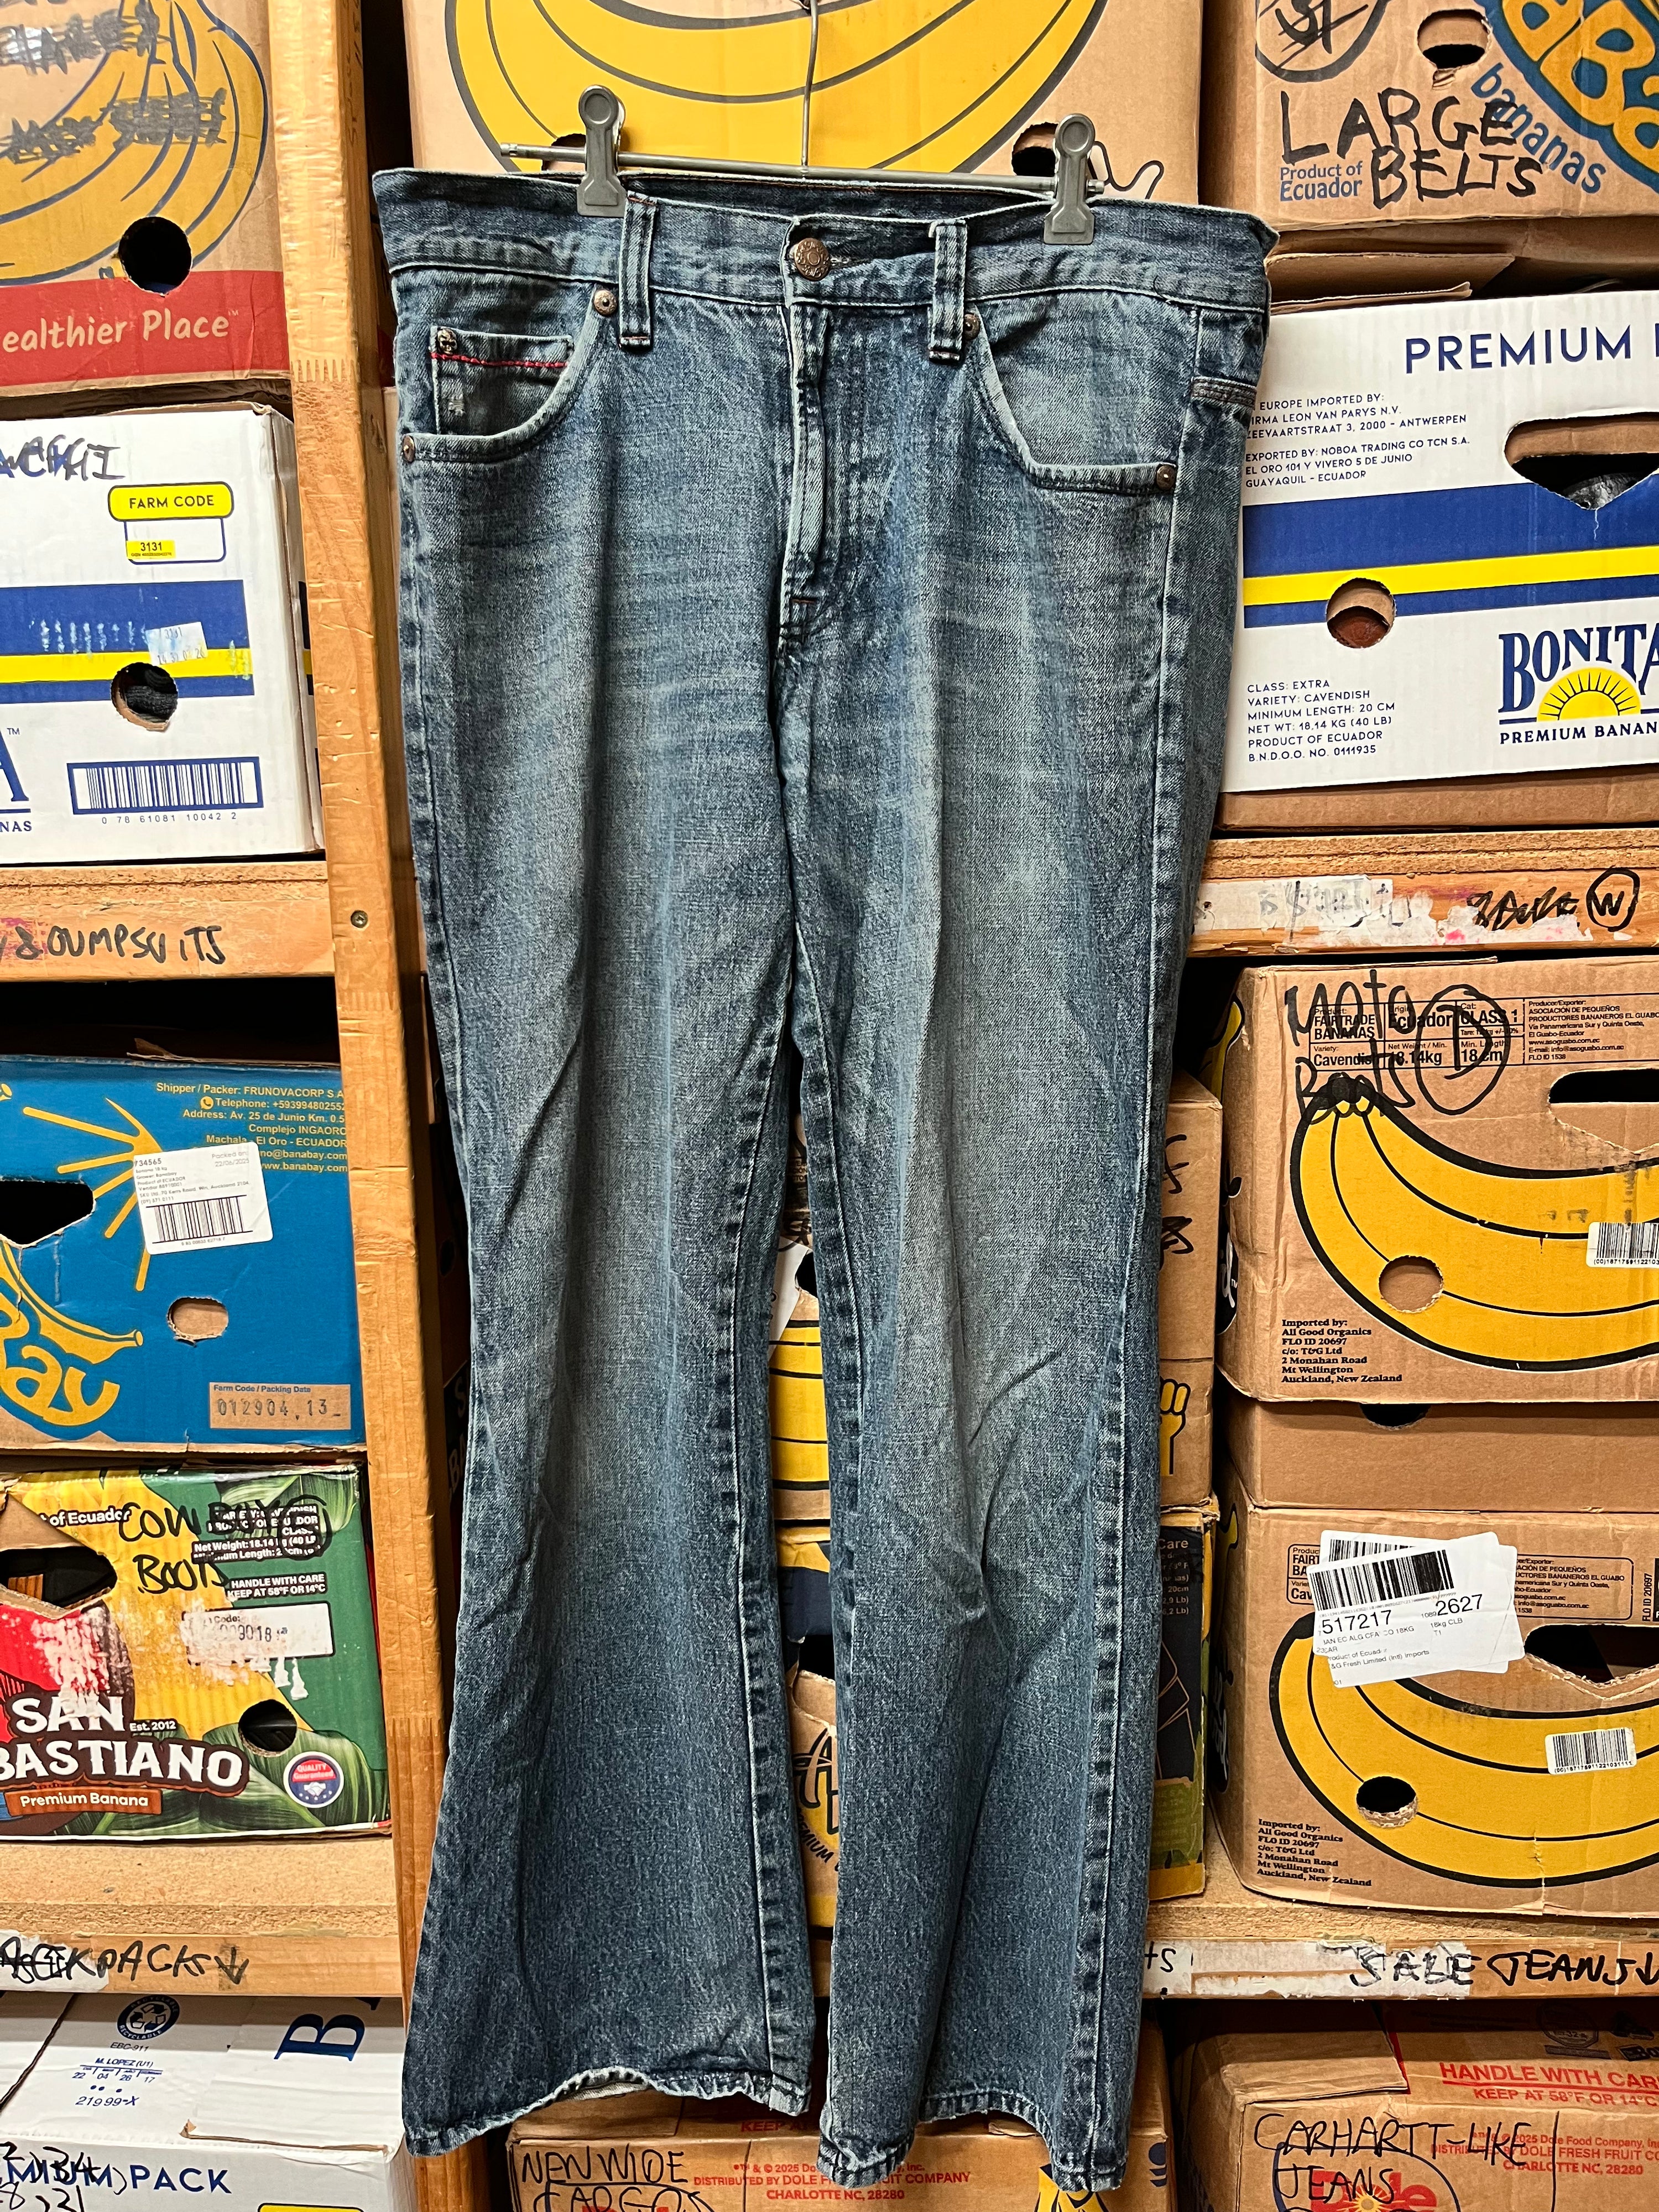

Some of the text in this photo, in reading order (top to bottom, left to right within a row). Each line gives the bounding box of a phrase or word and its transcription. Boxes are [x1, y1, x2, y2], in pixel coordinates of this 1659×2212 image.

[1281, 87, 1517, 164] LARGE
[1471, 62, 1606, 194] bananas
[1281, 161, 1363, 180] Product of
[1371, 145, 1543, 210] BELTS
[1280, 178, 1363, 202] Ecuador
[1406, 325, 1631, 374] PREMIUM
[1260, 393, 1385, 411] EUROPE IMPORTED BY:
[1283, 408, 1376, 423] LEON VAN PARYS
[1360, 415, 1467, 431] 2000 ANTWERPEN
[1245, 438, 1448, 463] EXPORTED NOBOA TRADING TCN
[1261, 453, 1413, 474] ORO VIVERO JUNIO
[1245, 471, 1366, 488] GUAYAQUIL ECUADOR
[129, 494, 215, 509] FARM CODE
[140, 541, 163, 552] 3131
[1248, 680, 1330, 693] CLASS: EXTRA
[1248, 690, 1370, 707] VARIETY: CAVENDISH
[1248, 702, 1395, 721] MINIMUM LENGTH: 20 CM
[1248, 719, 1346, 734] NET KG
[1500, 721, 1658, 745] PREMIUM BANAN
[1249, 731, 1383, 748] PRODUCT OF ECUADOR
[1249, 744, 1376, 762] B.N.D.O.O. 0111935
[139, 812, 222, 823] 61081 10042
[1528, 1006, 1571, 1015] ASOCIACIÓN
[156, 1082, 325, 1097] Shipper Packer: FRUNOVACORP
[215, 1098, 270, 1109] Telephone:
[183, 1109, 305, 1121] Address: Junio
[249, 1124, 296, 1135] Complejo
[269, 1137, 287, 1145] Oro
[296, 1138, 347, 1147] ECUADOR
[1282, 1318, 1329, 1328] Imported
[1327, 1327, 1372, 1337] Organics
[1298, 1366, 1353, 1375] Wellington
[1281, 1375, 1334, 1384] Auckland,
[50, 1511, 65, 1526] of
[118, 1502, 202, 1542] COW
[213, 1541, 249, 1551] Weight:
[239, 1549, 275, 1559] Length:
[231, 1574, 325, 1588] HANDLE WITH CARE
[227, 1585, 305, 1598] KEEP AT OR
[1322, 1594, 1483, 1635] 517217 2627
[12, 1695, 127, 1733] SAN
[152, 1720, 177, 1730] 2012
[20, 1792, 149, 1808] Premium Banana
[1258, 1818, 1303, 1830] Imported
[1274, 1829, 1343, 1843] Good Organics
[1292, 1839, 1319, 1849] 20697
[1265, 1853, 1339, 1867] Monahan Road
[1273, 1862, 1325, 1874] Wellington
[1257, 1868, 1371, 1887] Auckland, Zealand
[110, 2042, 150, 2052] EBC-911
[106, 2058, 137, 2067] LOPEZ
[1439, 2062, 1603, 2086] HANDLE WITH
[1473, 2088, 1615, 2106] KEEP AT OR
[1566, 2136, 1644, 2148] Food Company,
[1558, 2147, 1642, 2161] FRESH FRUIT
[597, 2143, 688, 2184] WIDE
[775, 2164, 799, 2173] 2025
[1606, 2164, 1644, 2176] 28280
[130, 2164, 232, 2194] PACK
[694, 2172, 972, 2186] DISTRIBUTED BY DOLE COMPANY
[1275, 2163, 1394, 2204] JEANS
[766, 2189, 905, 2201] CHARLOTTE 28280
